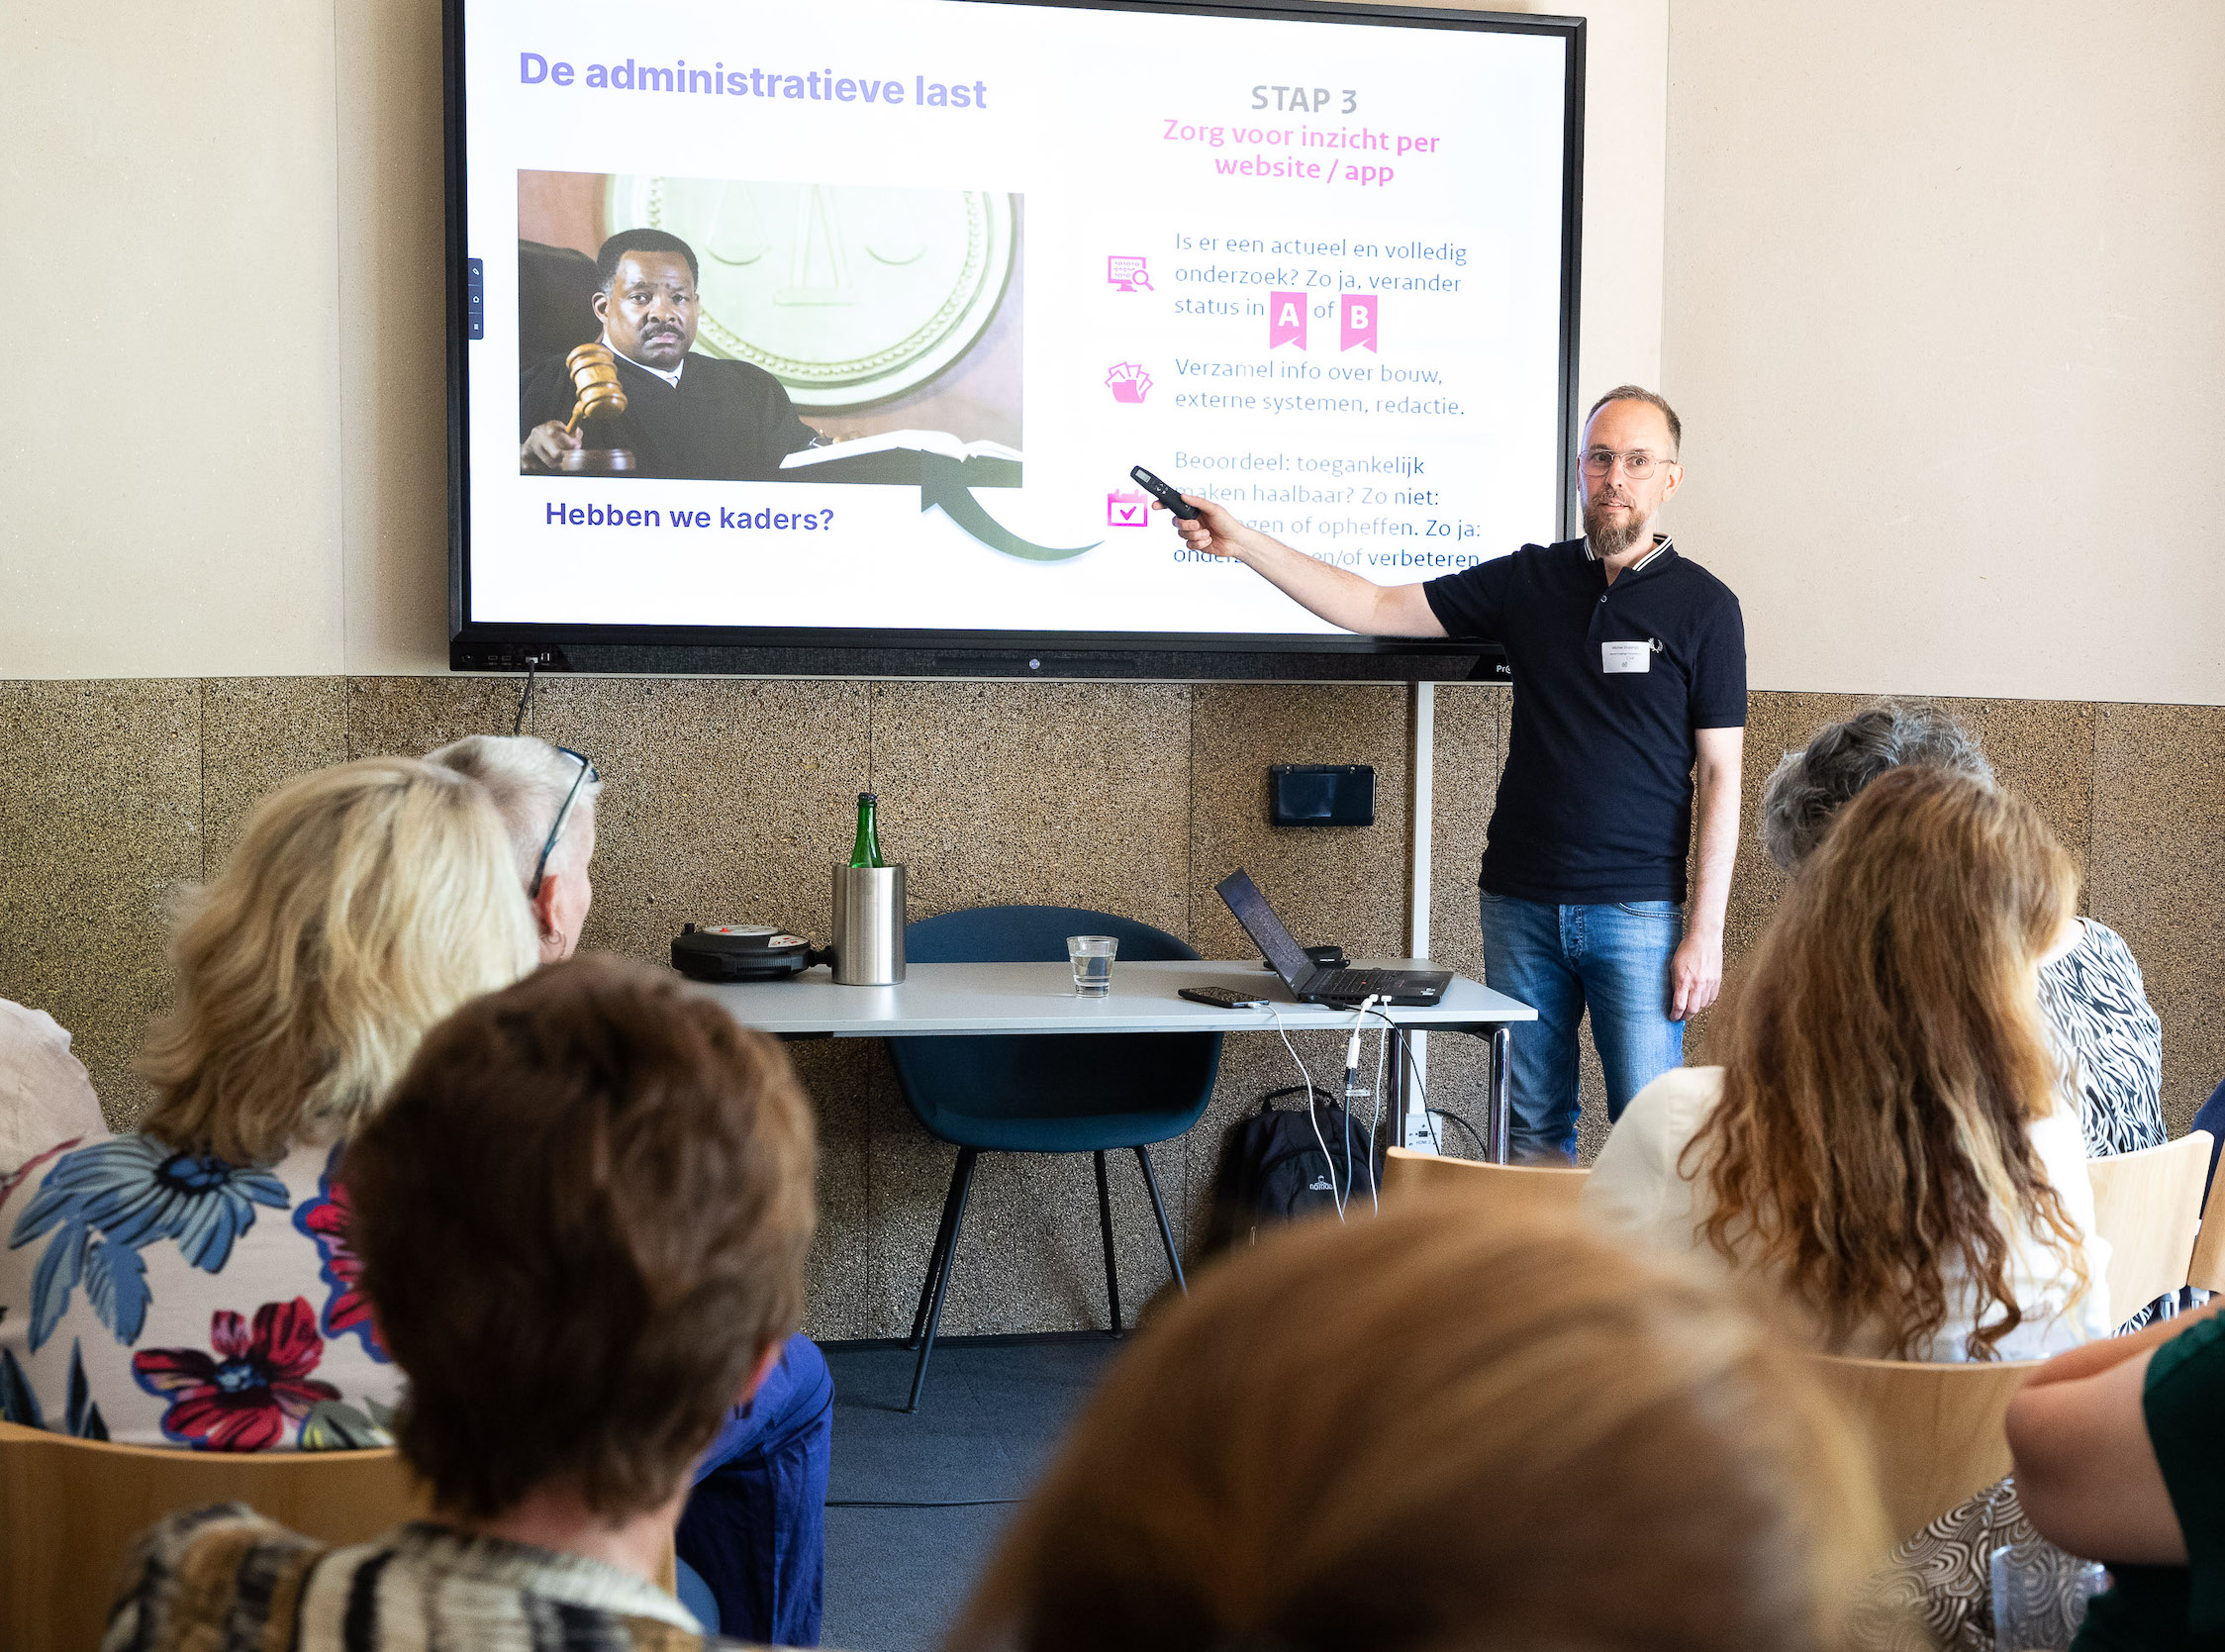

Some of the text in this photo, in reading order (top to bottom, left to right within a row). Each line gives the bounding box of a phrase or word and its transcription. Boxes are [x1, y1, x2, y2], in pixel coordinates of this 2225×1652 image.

[520, 52, 988, 109] De administratieve last
[1251, 85, 1357, 114] STAP 3
[1163, 119, 1440, 156] Zorg voor inzicht per
[1214, 154, 1395, 187] website / app
[1176, 233, 1468, 266] Is er een actueel en volledig
[1175, 265, 1462, 292] onderzoek? Zo ja, verander
[1175, 298, 1369, 329] status in A of B
[1175, 357, 1443, 385] Verzamel info over bouw,
[1175, 392, 1465, 416] externe systemen, redactie.
[1175, 452, 1425, 478] Beoordeel: toegankelijk
[1253, 484, 1355, 503] haalbaar?
[1362, 486, 1388, 504] Zo
[1395, 487, 1439, 506] niet:
[546, 502, 834, 531] Hebben we kaders?
[1291, 516, 1312, 534] of
[1318, 518, 1418, 539] opheffen.
[1425, 520, 1452, 536] Zo
[1456, 520, 1481, 541] ja:
[1367, 549, 1480, 567] verbeteren
